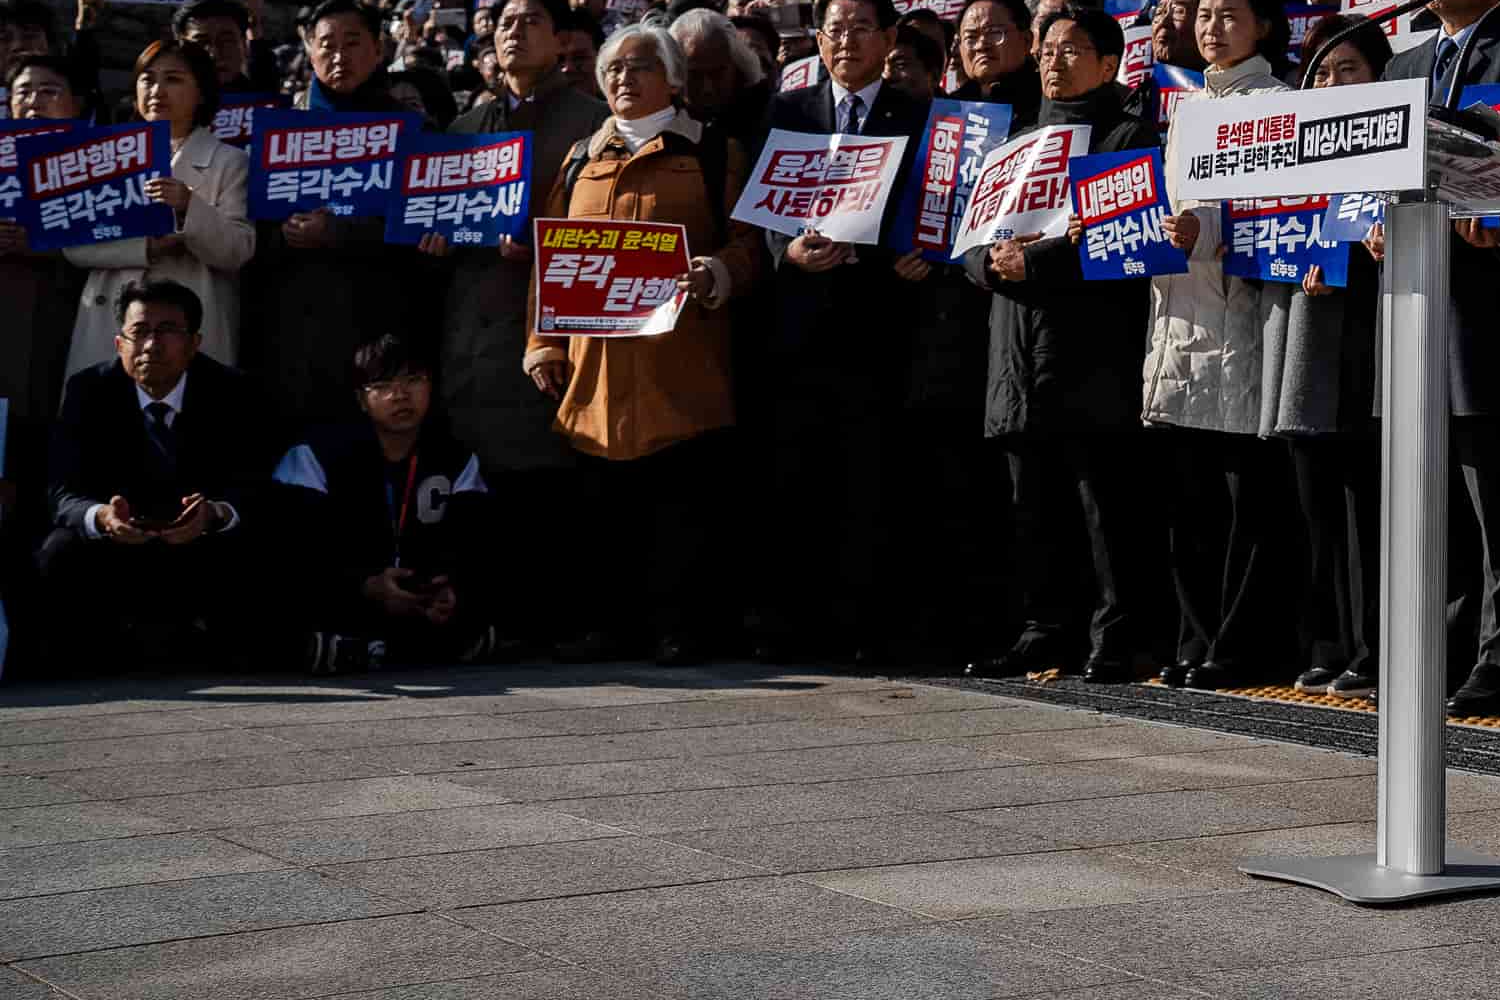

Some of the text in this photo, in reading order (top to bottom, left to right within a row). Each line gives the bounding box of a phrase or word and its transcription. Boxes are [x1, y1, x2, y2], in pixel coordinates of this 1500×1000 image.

[268, 123, 399, 164] 내란행위
[1216, 112, 1296, 150] 윤석열 대통령
[1303, 110, 1404, 158] 비상시국대회
[31, 131, 149, 193] 내란행위
[408, 142, 520, 188] 내란행위
[770, 147, 885, 183] 윤석열은
[1188, 153, 1214, 181] 사퇴
[1270, 140, 1297, 169] 추진
[753, 184, 881, 219] 사퇴하라!
[918, 120, 961, 244] 내란행위
[1080, 161, 1154, 219] 내란행위
[404, 182, 524, 227] 즉각수사!
[453, 231, 483, 242] 민주당
[543, 228, 678, 252] 내란수괴 윤석열
[544, 253, 616, 289] 즉각
[1123, 260, 1145, 275] 민주당
[1270, 261, 1298, 278] 민주당
[417, 475, 451, 525] C
